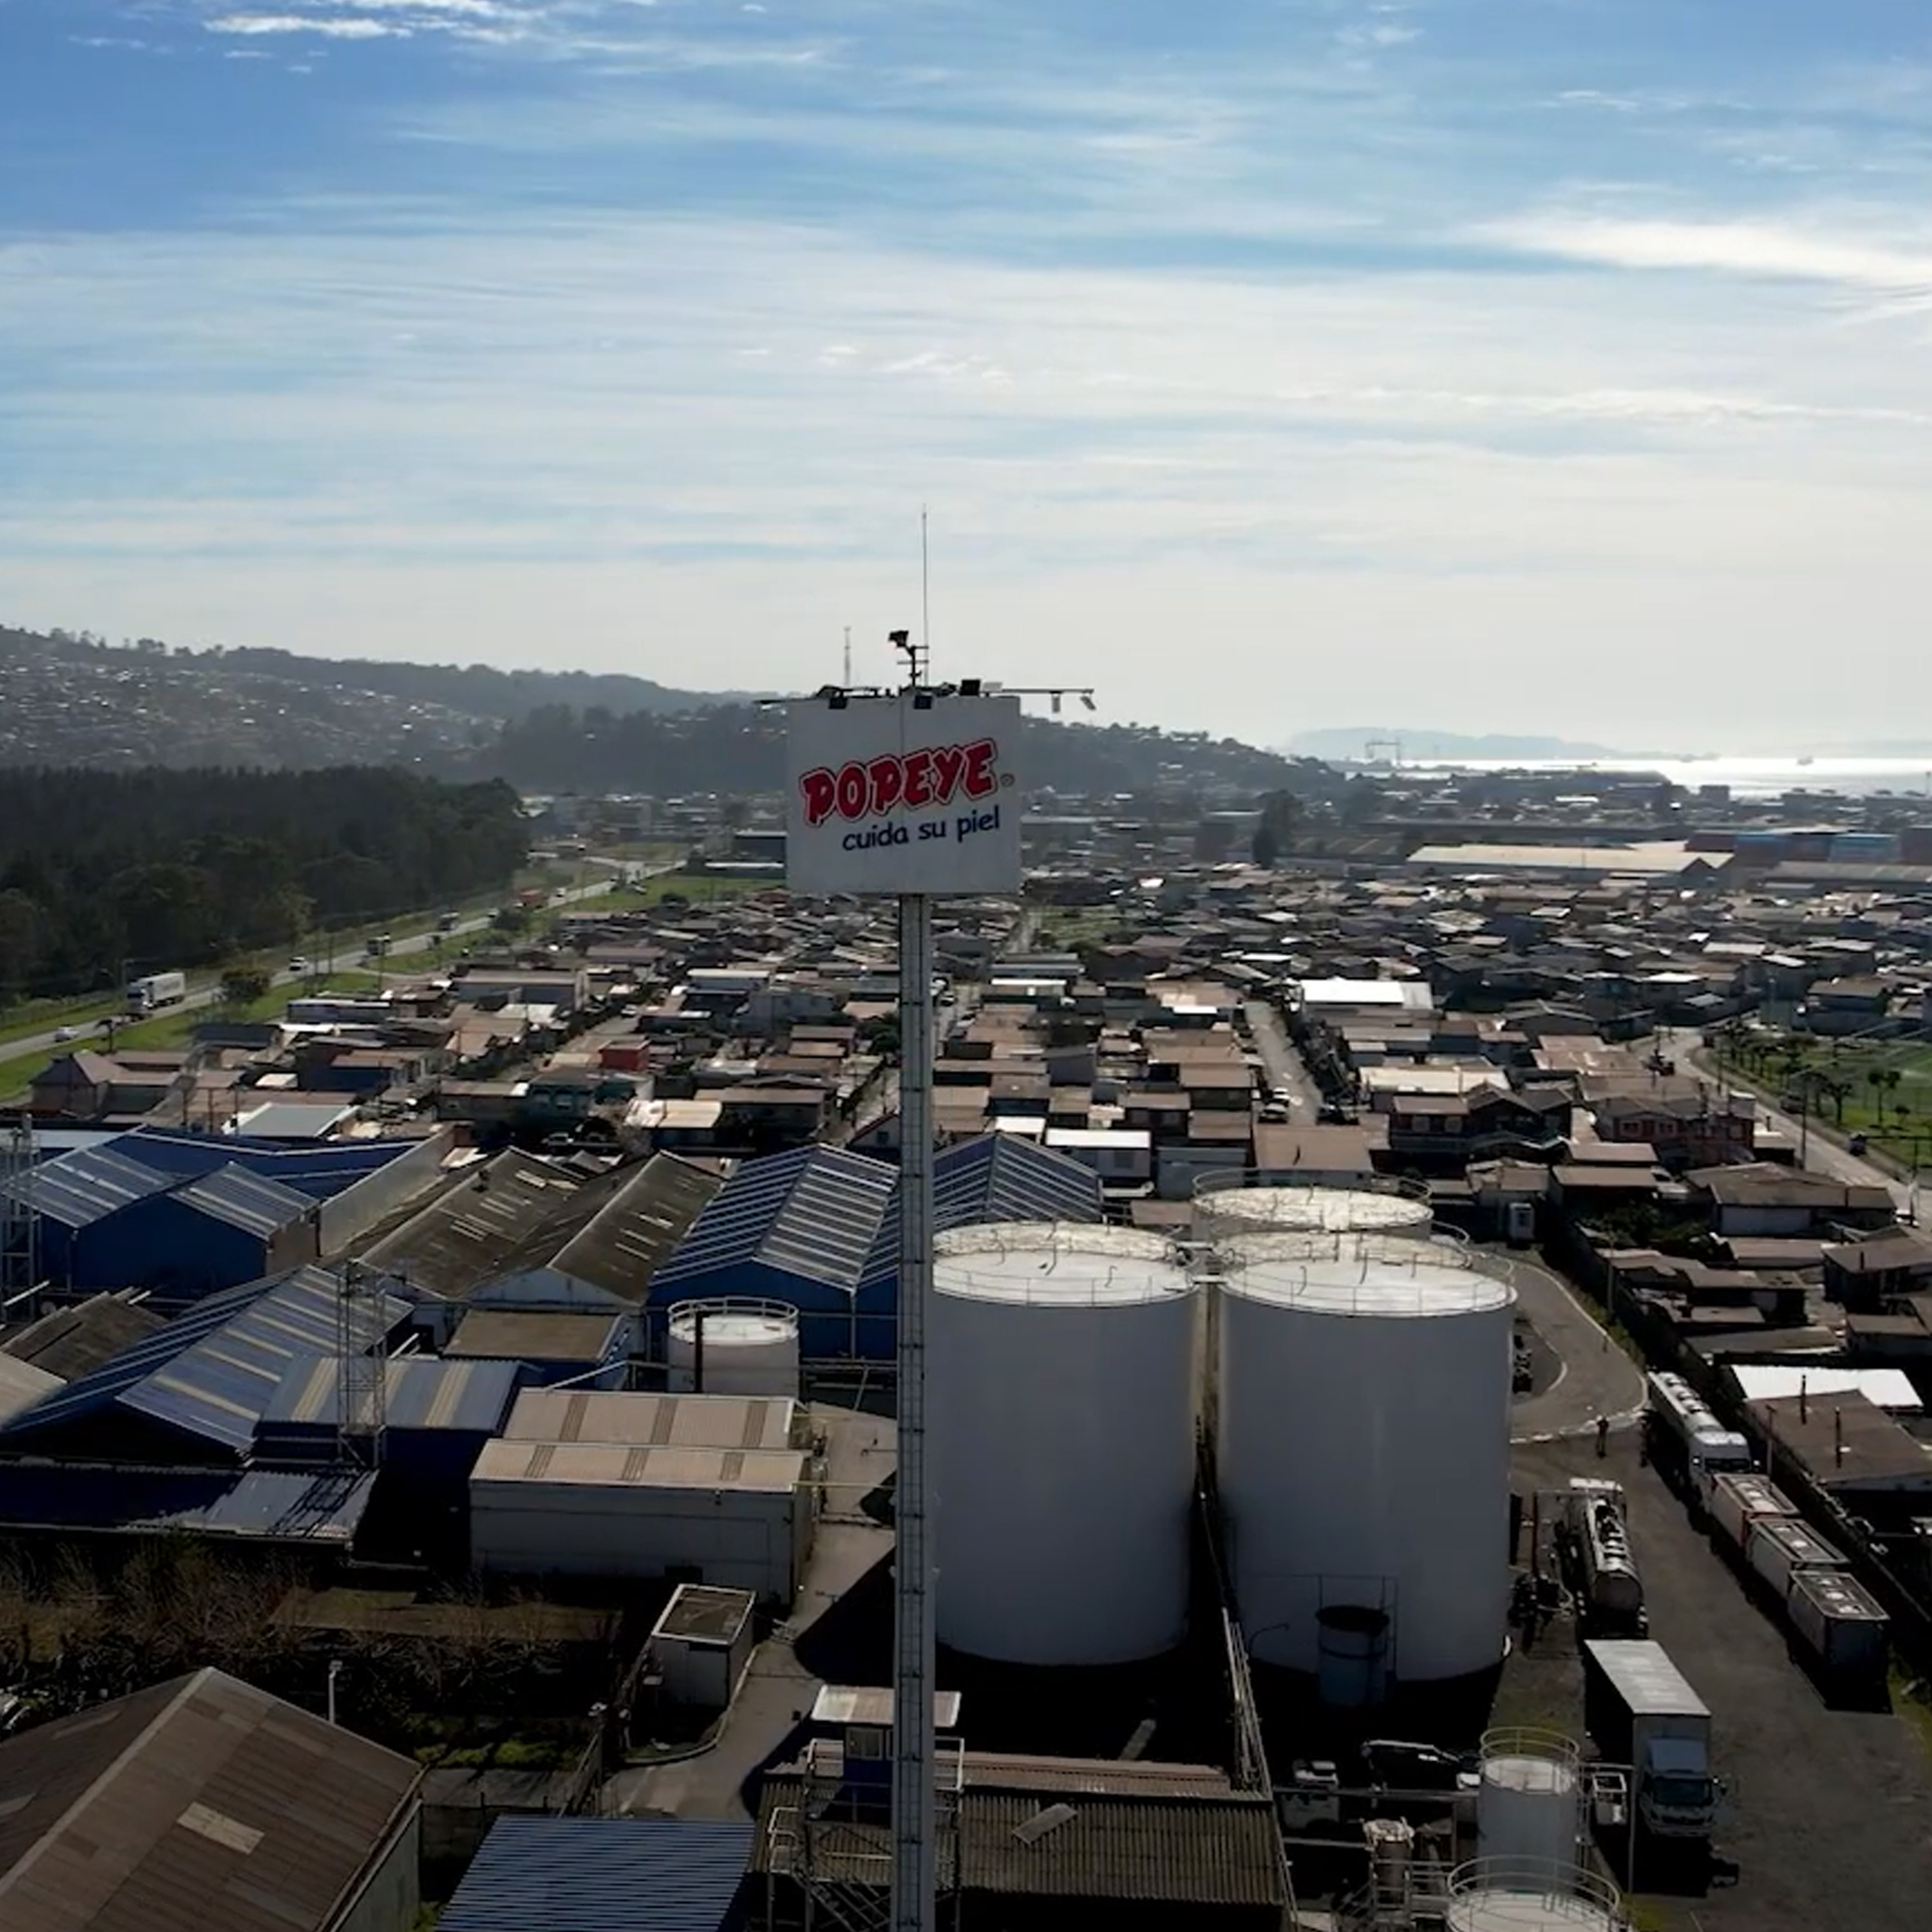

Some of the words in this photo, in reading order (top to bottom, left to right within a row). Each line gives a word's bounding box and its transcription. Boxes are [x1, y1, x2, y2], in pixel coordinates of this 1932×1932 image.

[799, 738, 996, 827] POPEYE
[842, 821, 909, 851] cuida
[918, 815, 946, 840] su
[957, 806, 1000, 842] piel
